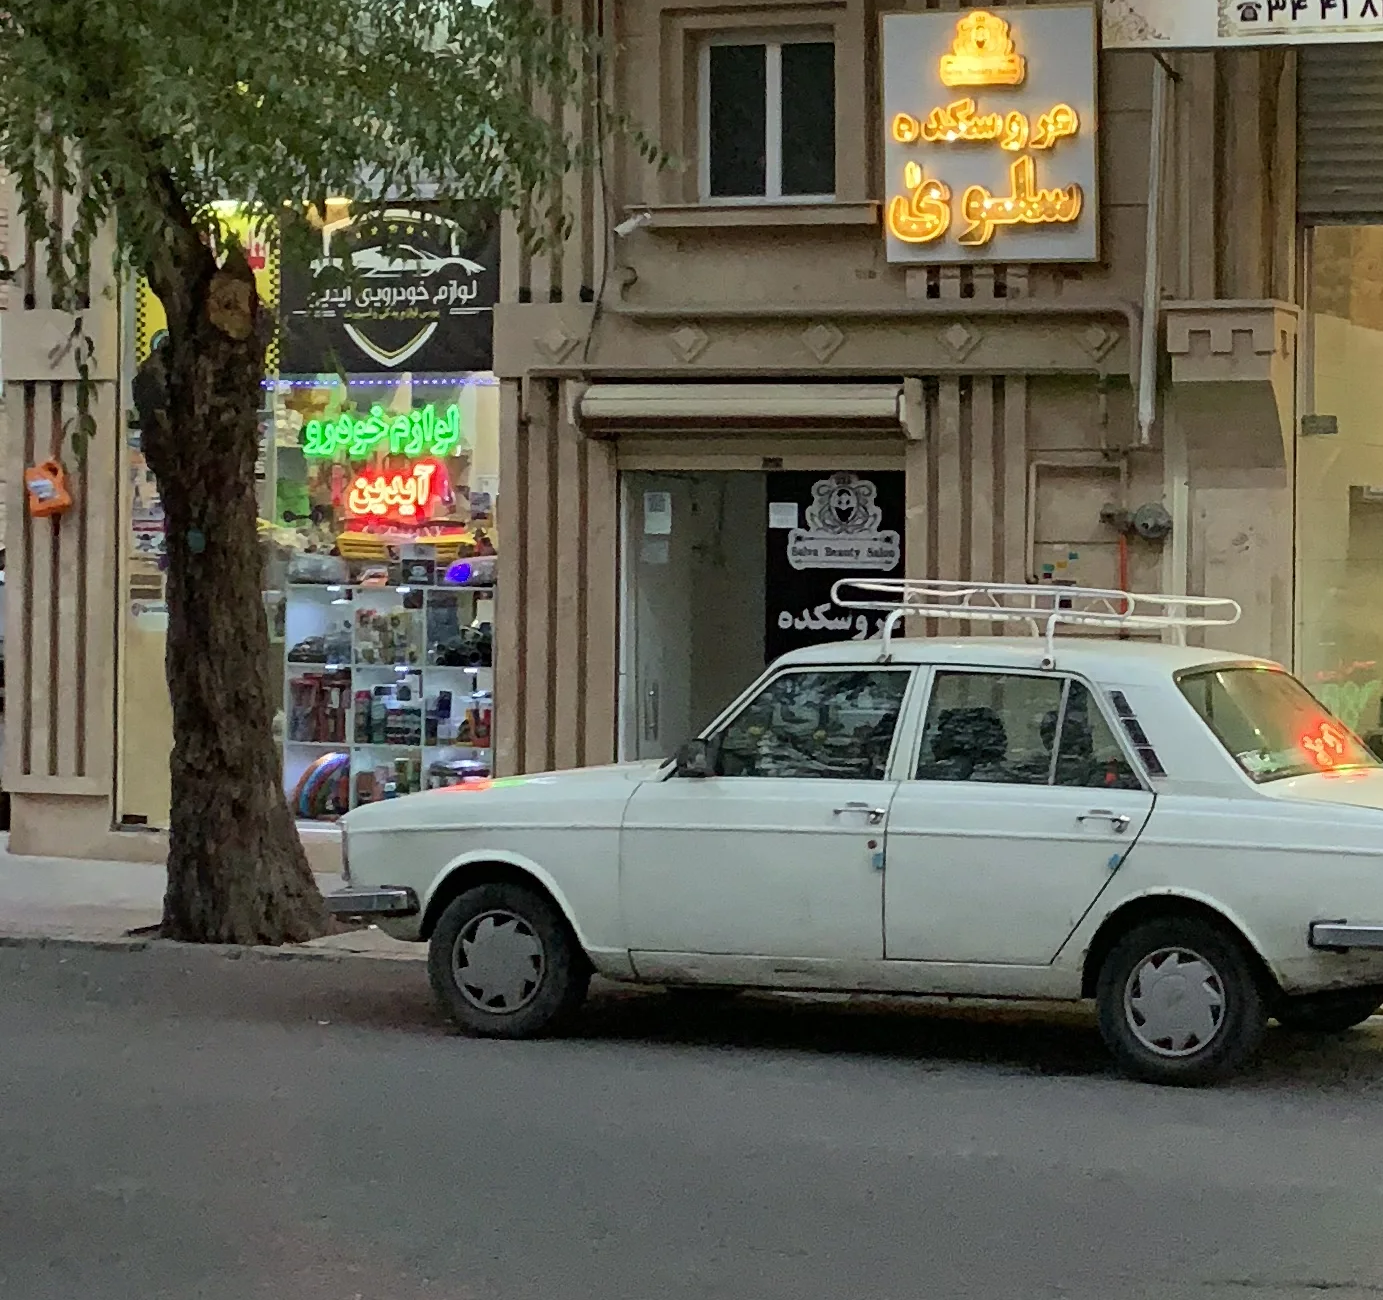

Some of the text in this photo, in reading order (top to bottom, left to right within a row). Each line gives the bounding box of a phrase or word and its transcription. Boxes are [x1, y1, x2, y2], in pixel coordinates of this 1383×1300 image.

[892, 97, 1079, 151] عروسکده
[432, 278, 478, 305] لوازم
[389, 403, 461, 455] لوازم
[348, 463, 437, 516] آیدین
[824, 546, 861, 560] Beauty
